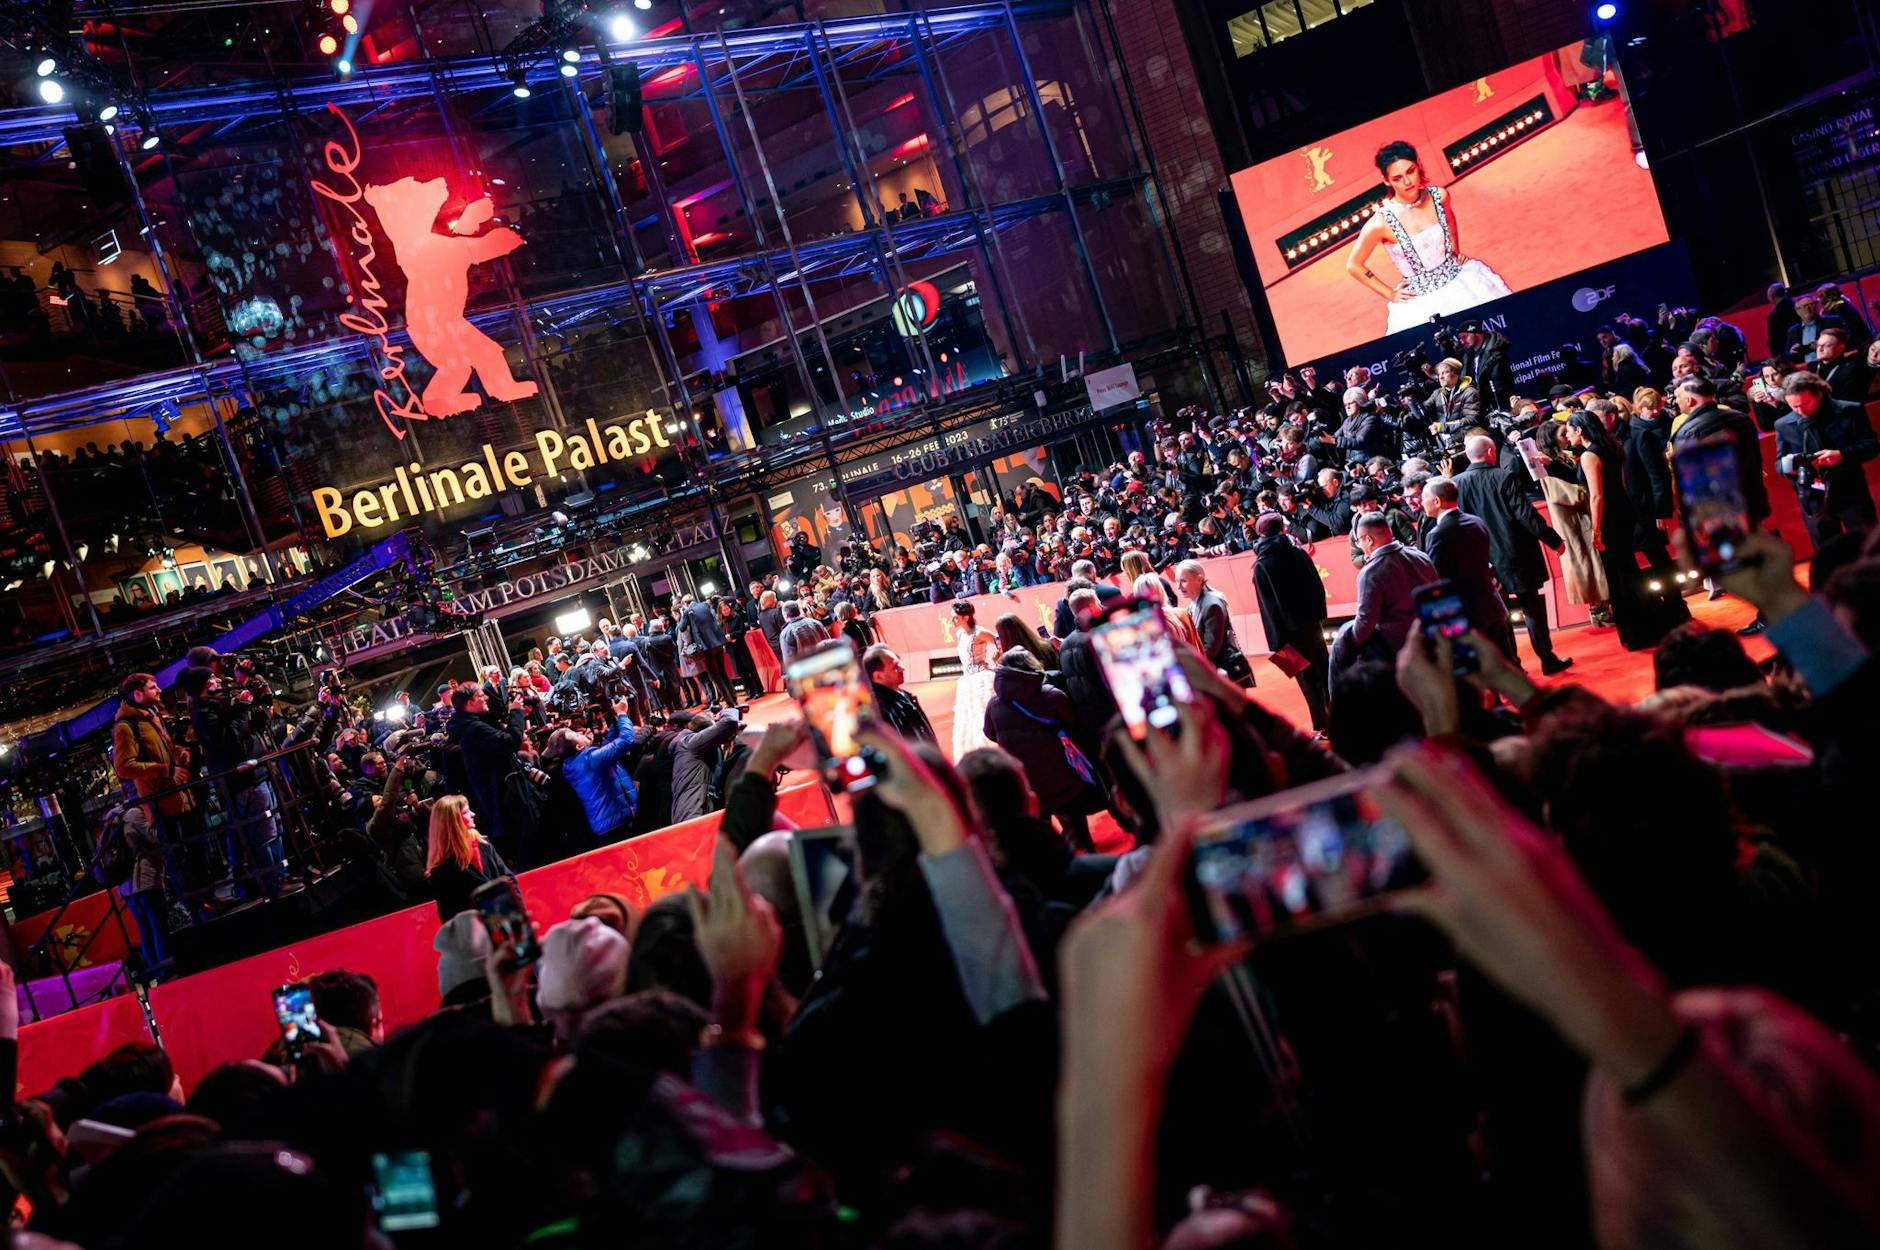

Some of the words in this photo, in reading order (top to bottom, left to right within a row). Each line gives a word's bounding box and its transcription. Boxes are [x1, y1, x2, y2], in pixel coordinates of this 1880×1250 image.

[1836, 108, 1873, 130] ROYAL
[1845, 142, 1880, 163] LGER
[311, 101, 429, 439] Berlinale
[1585, 284, 1616, 305] ZDF
[1481, 314, 1508, 332] ANI
[1533, 353, 1551, 365] Film
[850, 405, 875, 420] Studio
[895, 448, 949, 481] CLUB
[948, 423, 1041, 462] THEATER
[1040, 403, 1097, 435] BERLI
[312, 443, 533, 539] Berlinale
[535, 408, 671, 479] Palast
[450, 588, 496, 616] AM
[498, 545, 648, 606] POTSDAM
